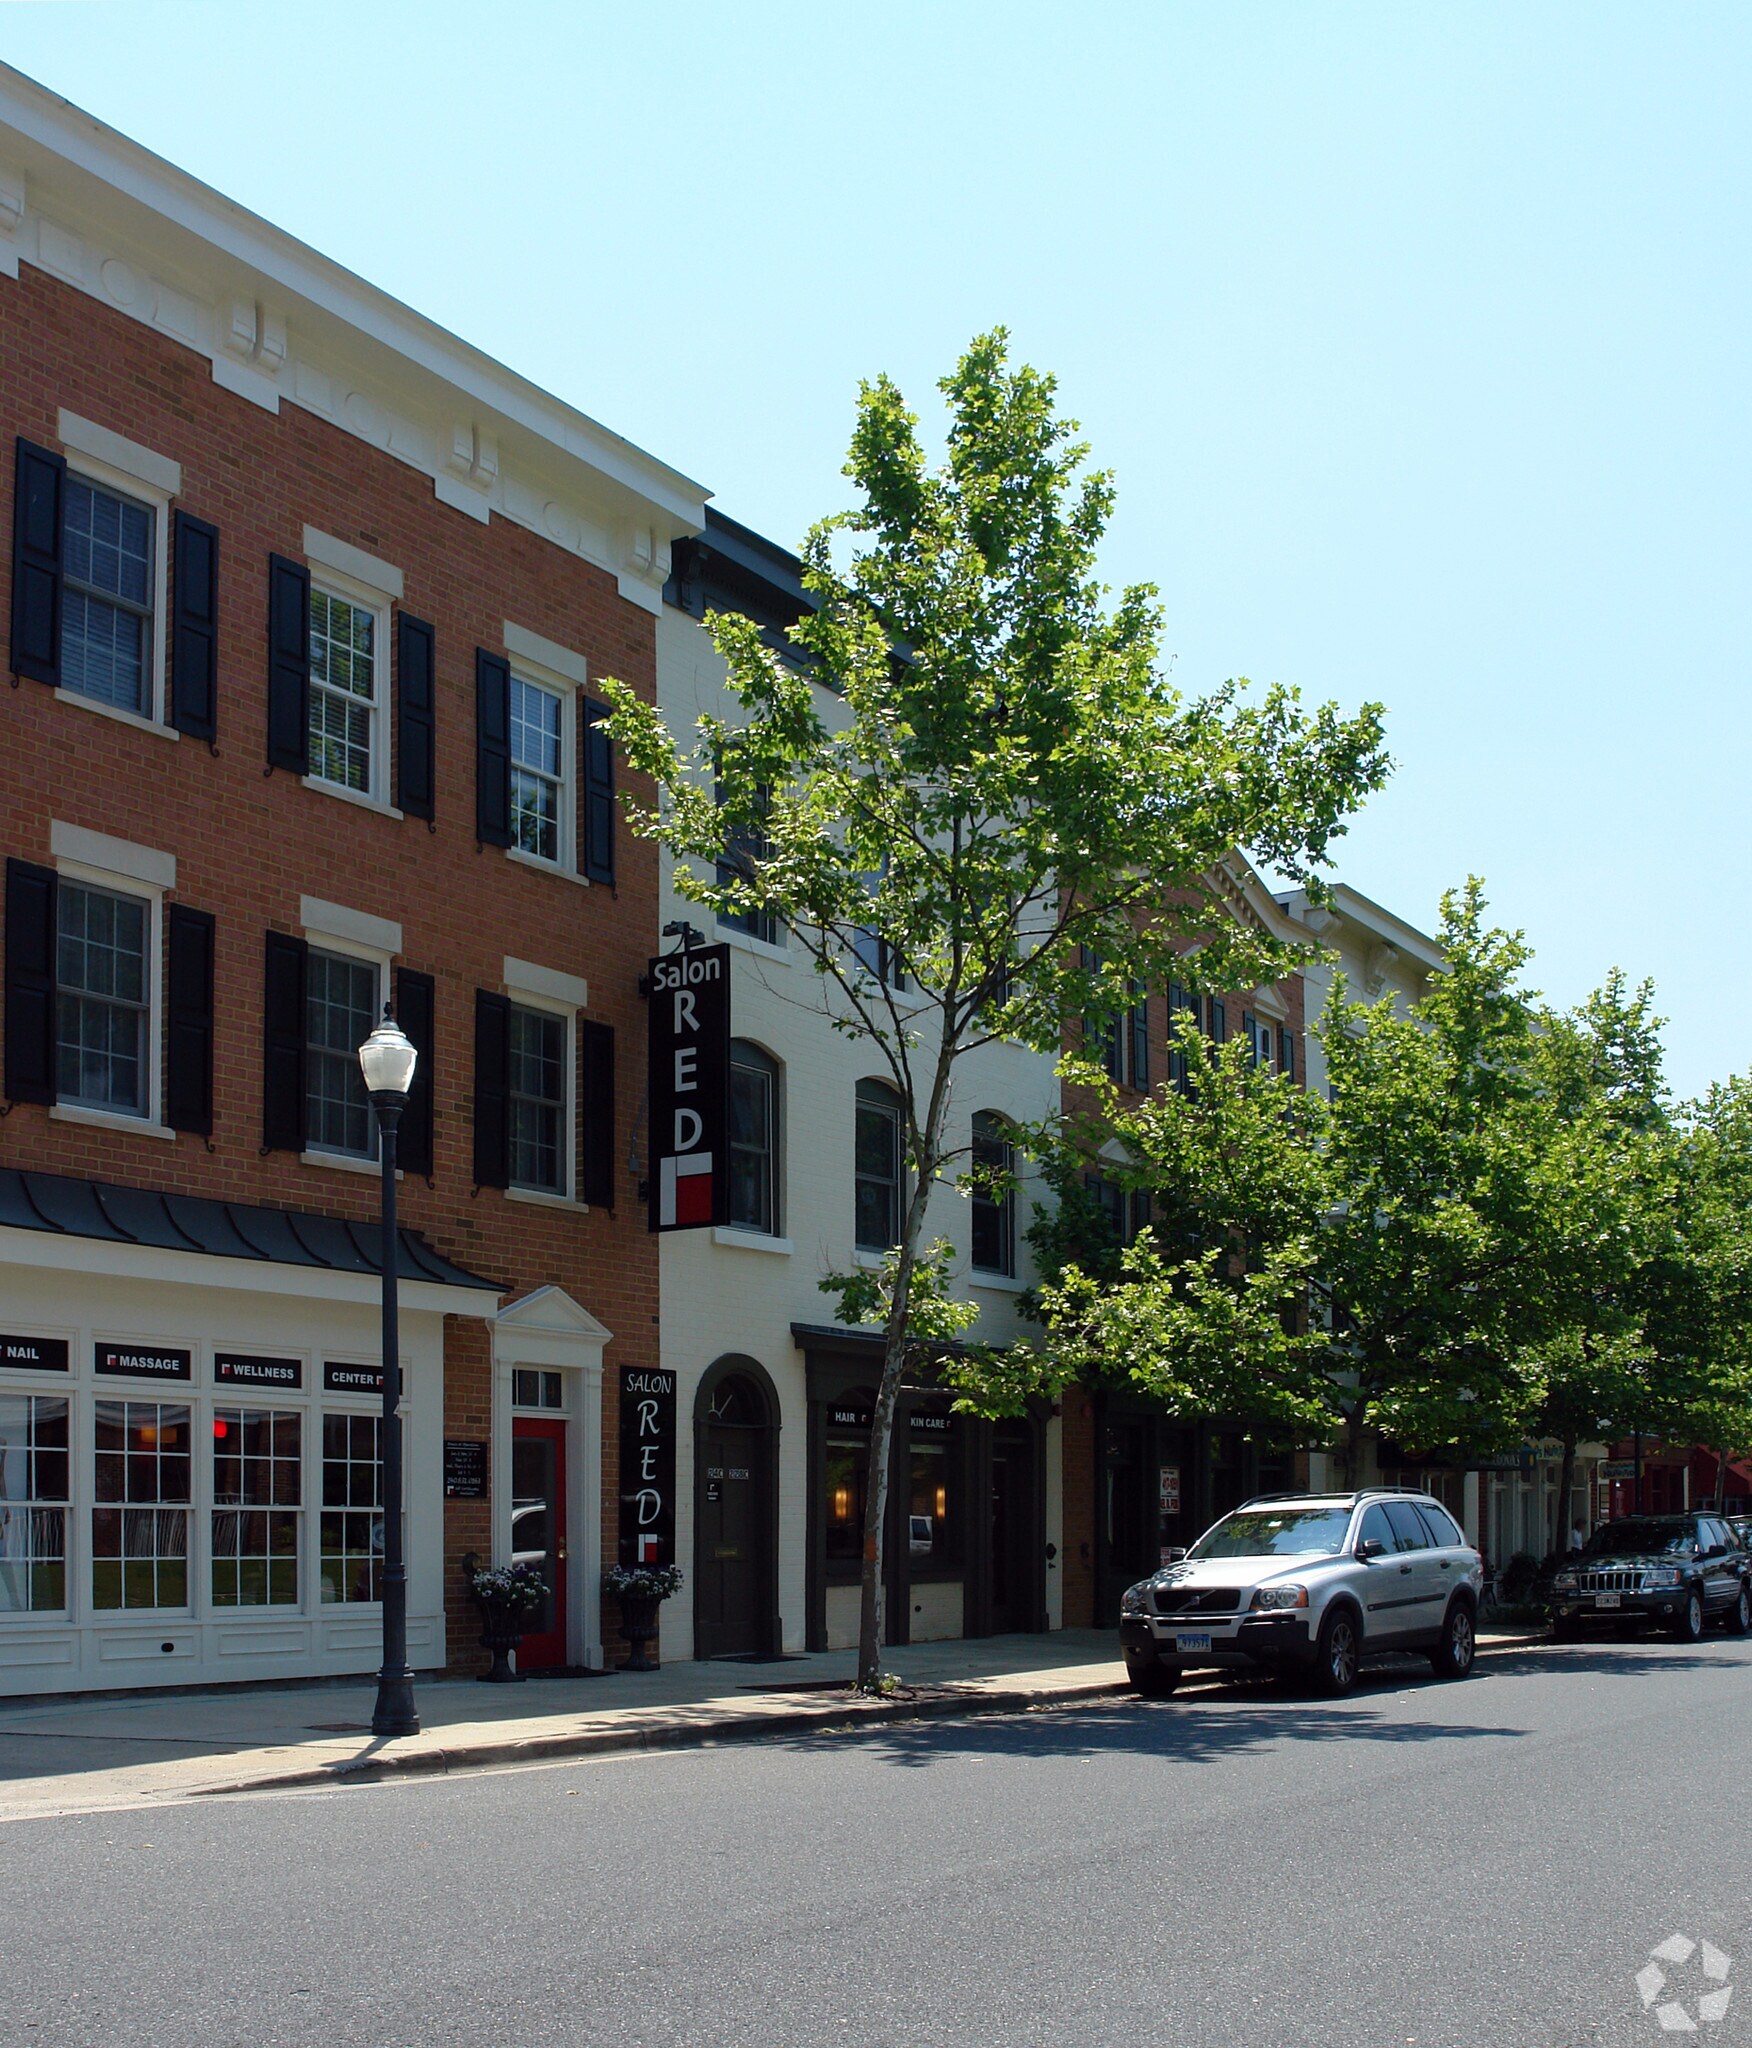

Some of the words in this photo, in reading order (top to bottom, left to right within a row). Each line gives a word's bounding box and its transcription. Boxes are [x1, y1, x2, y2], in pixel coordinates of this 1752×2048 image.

[653, 955, 720, 992] Salon
[674, 989, 703, 1152] RED
[7, 1346, 40, 1360] NAIL
[119, 1355, 180, 1371] MASSAGE
[233, 1364, 295, 1380] WELLNESS
[331, 1371, 374, 1385] CENTER
[626, 1373, 672, 1394] SALON
[835, 1411, 856, 1423] HAIR
[910, 1417, 924, 1428] KIN
[926, 1418, 945, 1429] CARE
[635, 1399, 662, 1526] RED
